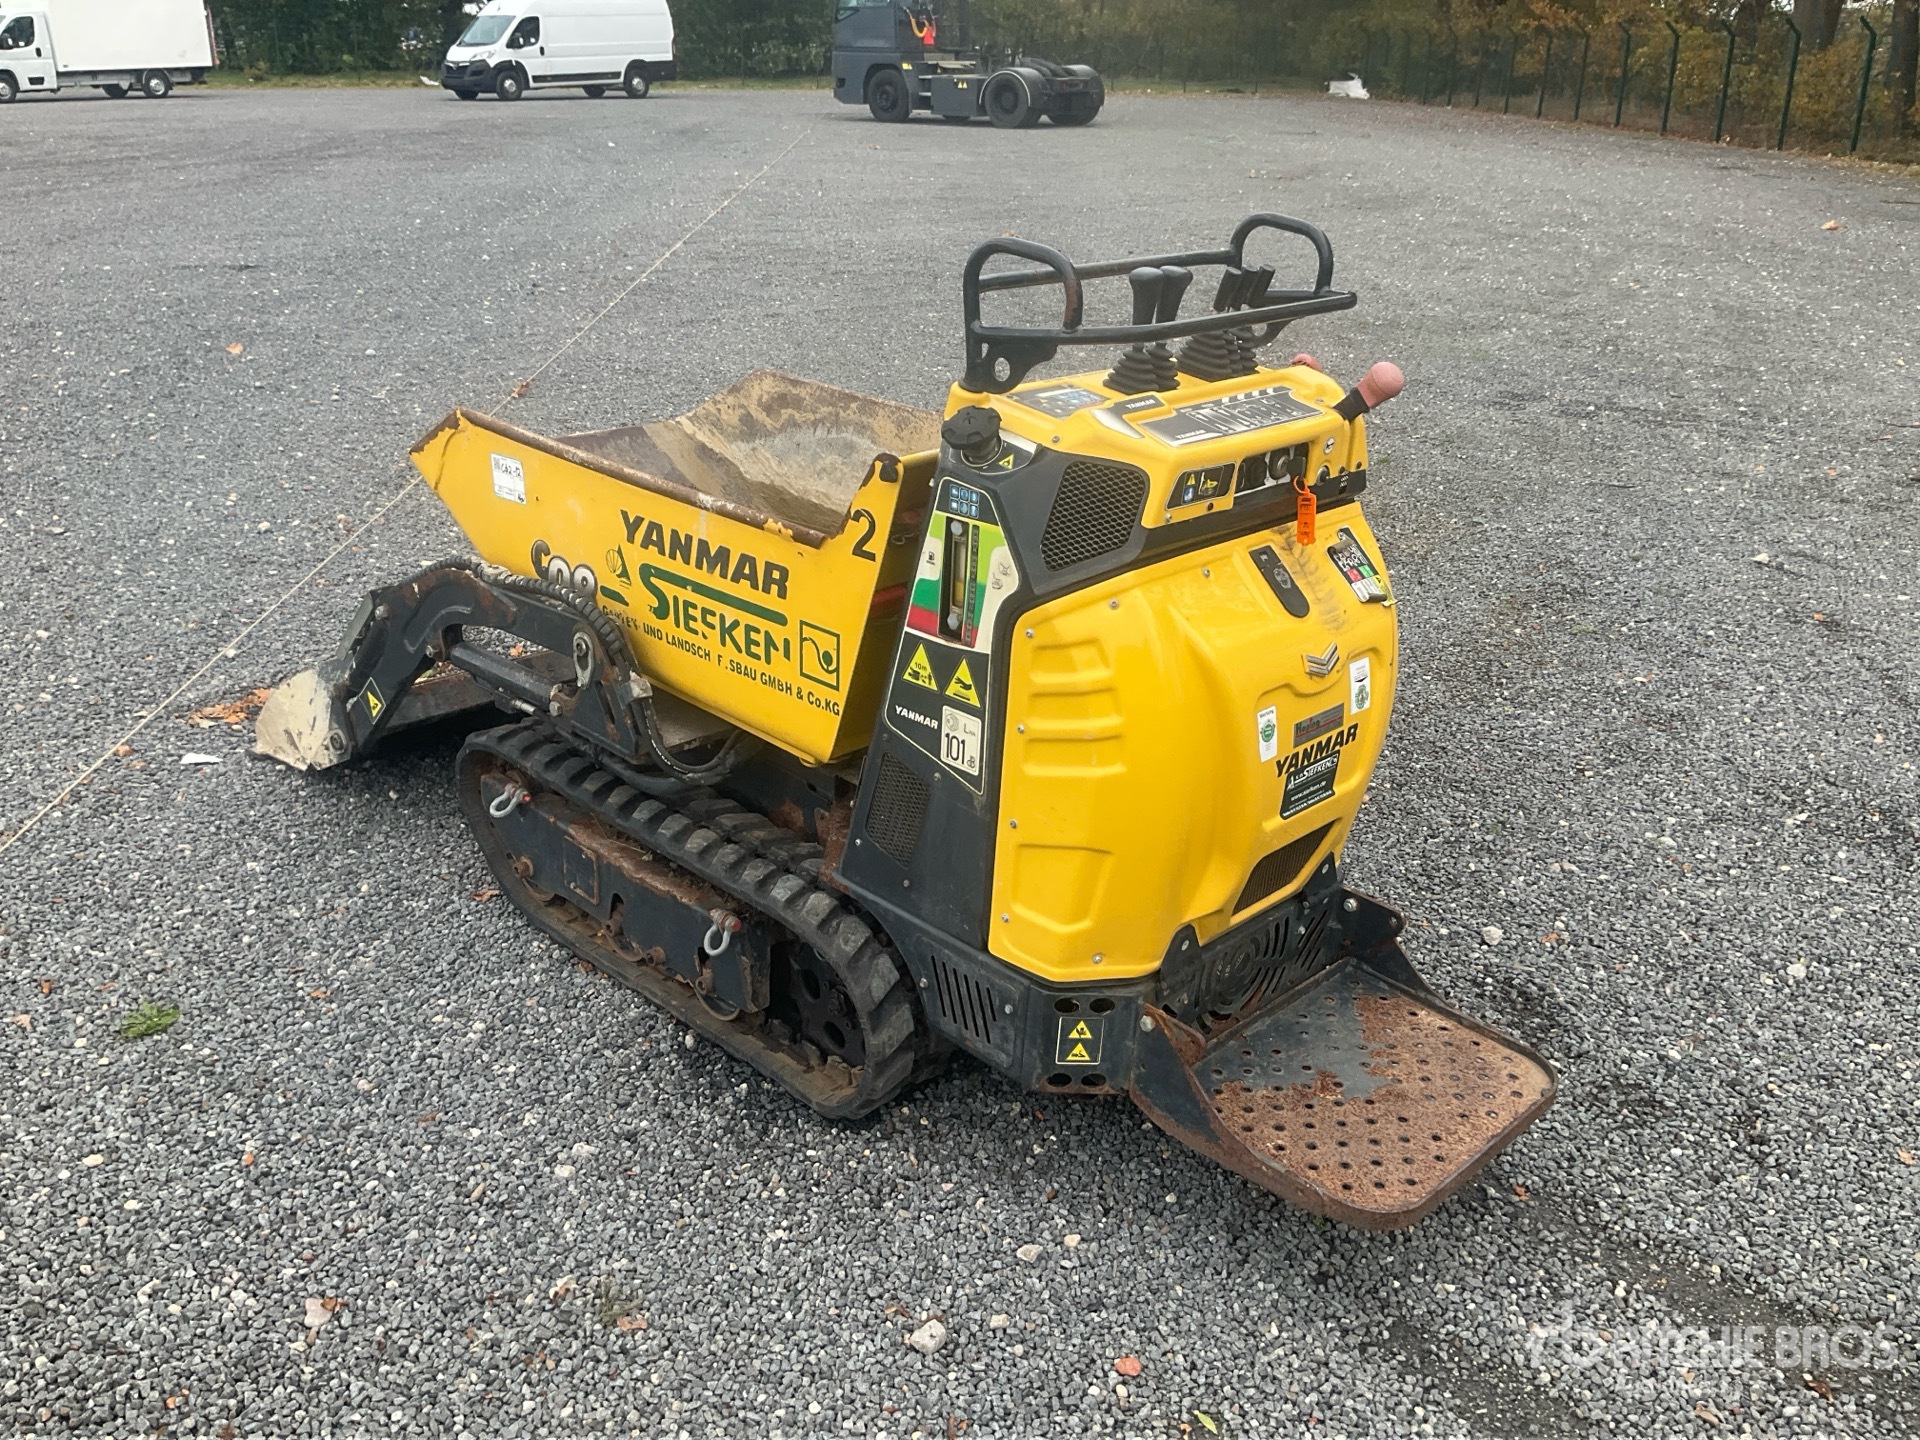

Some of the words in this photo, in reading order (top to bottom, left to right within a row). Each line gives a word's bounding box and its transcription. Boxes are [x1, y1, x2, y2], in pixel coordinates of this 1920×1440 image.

[620, 509, 790, 599] YANMAR
[852, 508, 876, 562] 2
[643, 622, 663, 641] UND
[760, 671, 793, 696] GMBH
[796, 687, 804, 702] &
[895, 705, 939, 730] YANMAR
[945, 732, 966, 765] 101
[1275, 722, 1358, 777] YANMAR
